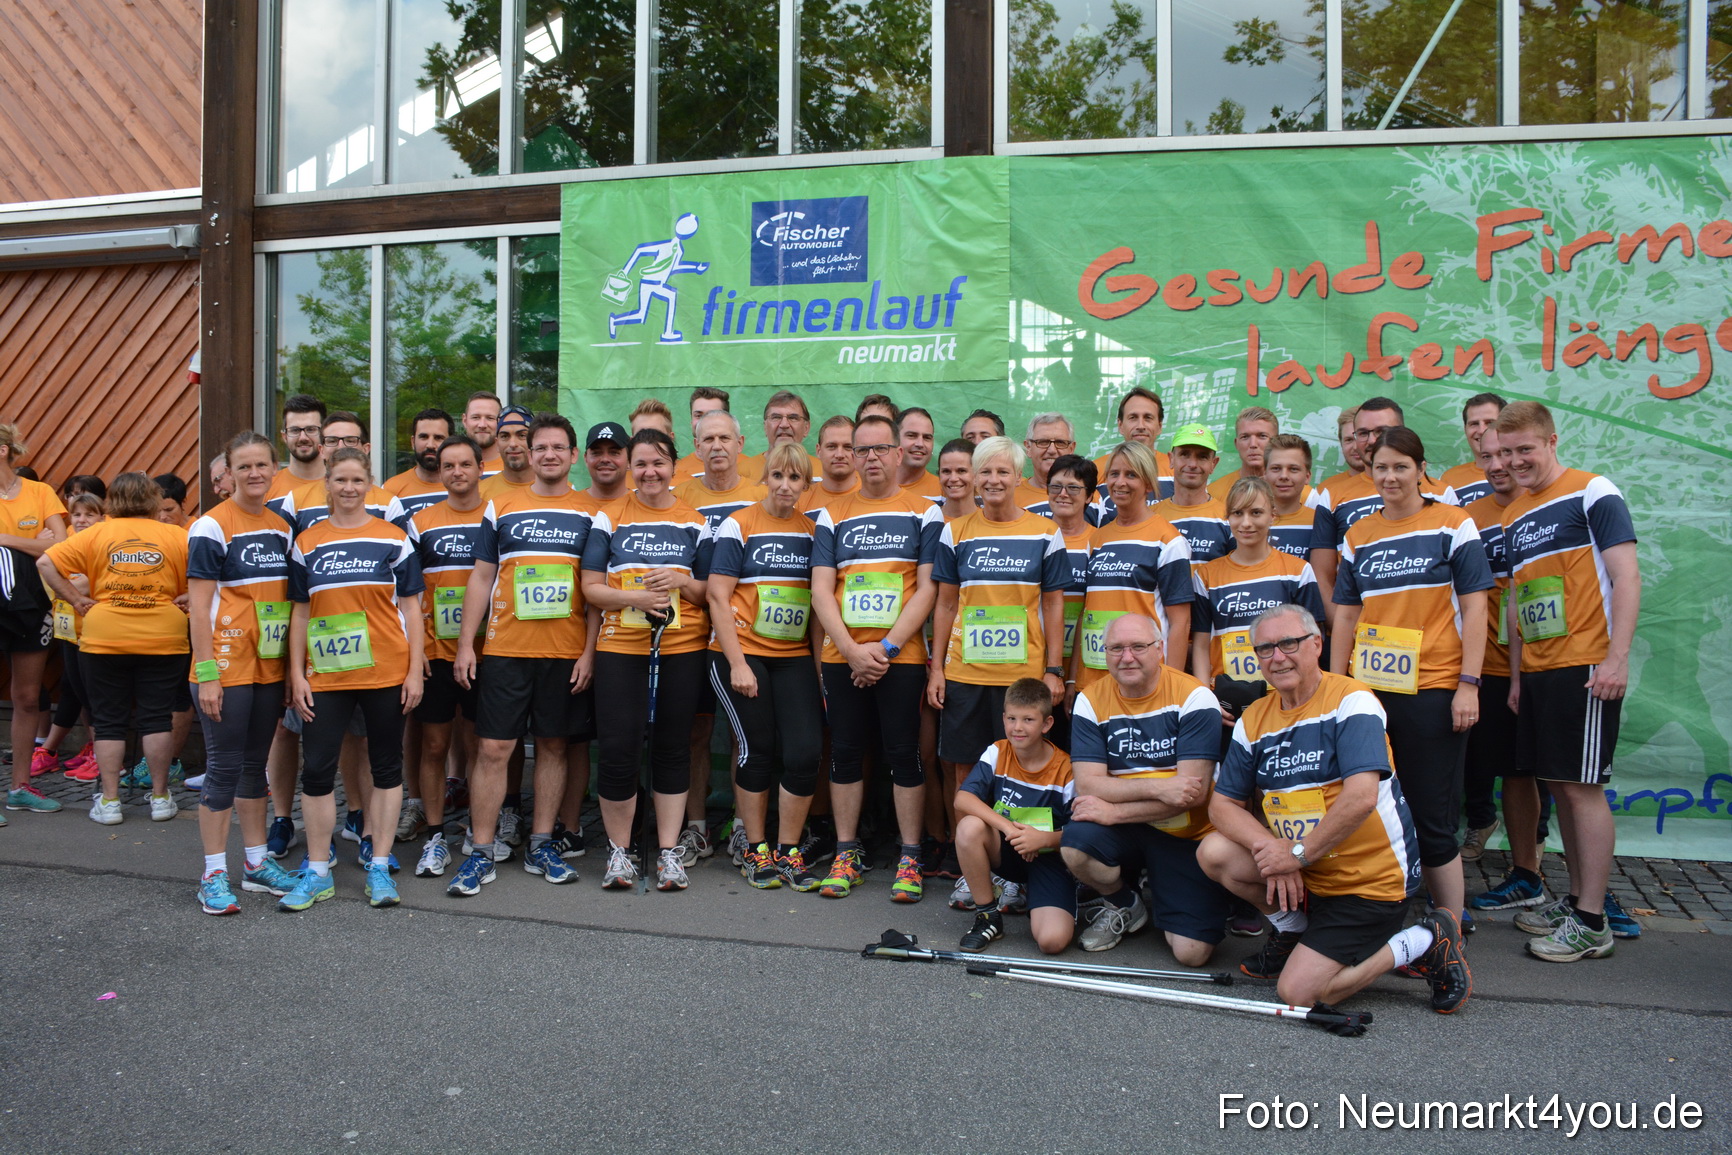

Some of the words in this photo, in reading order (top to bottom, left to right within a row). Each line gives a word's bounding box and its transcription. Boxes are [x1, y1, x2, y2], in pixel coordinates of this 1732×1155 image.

[773, 224, 850, 242] Fischer
[780, 240, 844, 250] AUTOMOBILE
[791, 258, 808, 268] und
[810, 255, 826, 265] das
[838, 262, 858, 272] mit!
[1078, 220, 1433, 320] Gesunde
[702, 276, 968, 336] firmenlauf
[838, 335, 958, 364] neumarkt
[1246, 311, 1496, 396] laufen
[522, 524, 578, 539] Fischer
[854, 532, 908, 544] Fischer
[1518, 522, 1559, 546] Fischer
[444, 542, 475, 552] Fisc
[634, 540, 686, 552] Fischer
[1273, 544, 1308, 554] cher
[111, 550, 147, 566] plank
[764, 548, 809, 564] Fischer
[976, 556, 1030, 566] Fischer
[1369, 556, 1432, 572] Fischer
[322, 558, 378, 571] Fischer
[326, 568, 374, 576] AUTOMOBILE
[1092, 560, 1138, 572] Fischer
[1375, 568, 1426, 580] AUTOMOBILE
[521, 586, 568, 604] 1625
[848, 594, 896, 612] 1637
[1227, 598, 1282, 612] Fischer
[1522, 600, 1556, 626] 1621
[764, 606, 804, 626] 1636
[1232, 610, 1266, 618] AUTOMO
[314, 634, 362, 658] 1427
[969, 628, 1020, 648] 1629
[1230, 656, 1261, 675] 16
[1360, 648, 1412, 676] 1620
[1119, 736, 1178, 754] Fischer
[1266, 749, 1324, 772] Fischer
[1274, 818, 1320, 840] 1627
